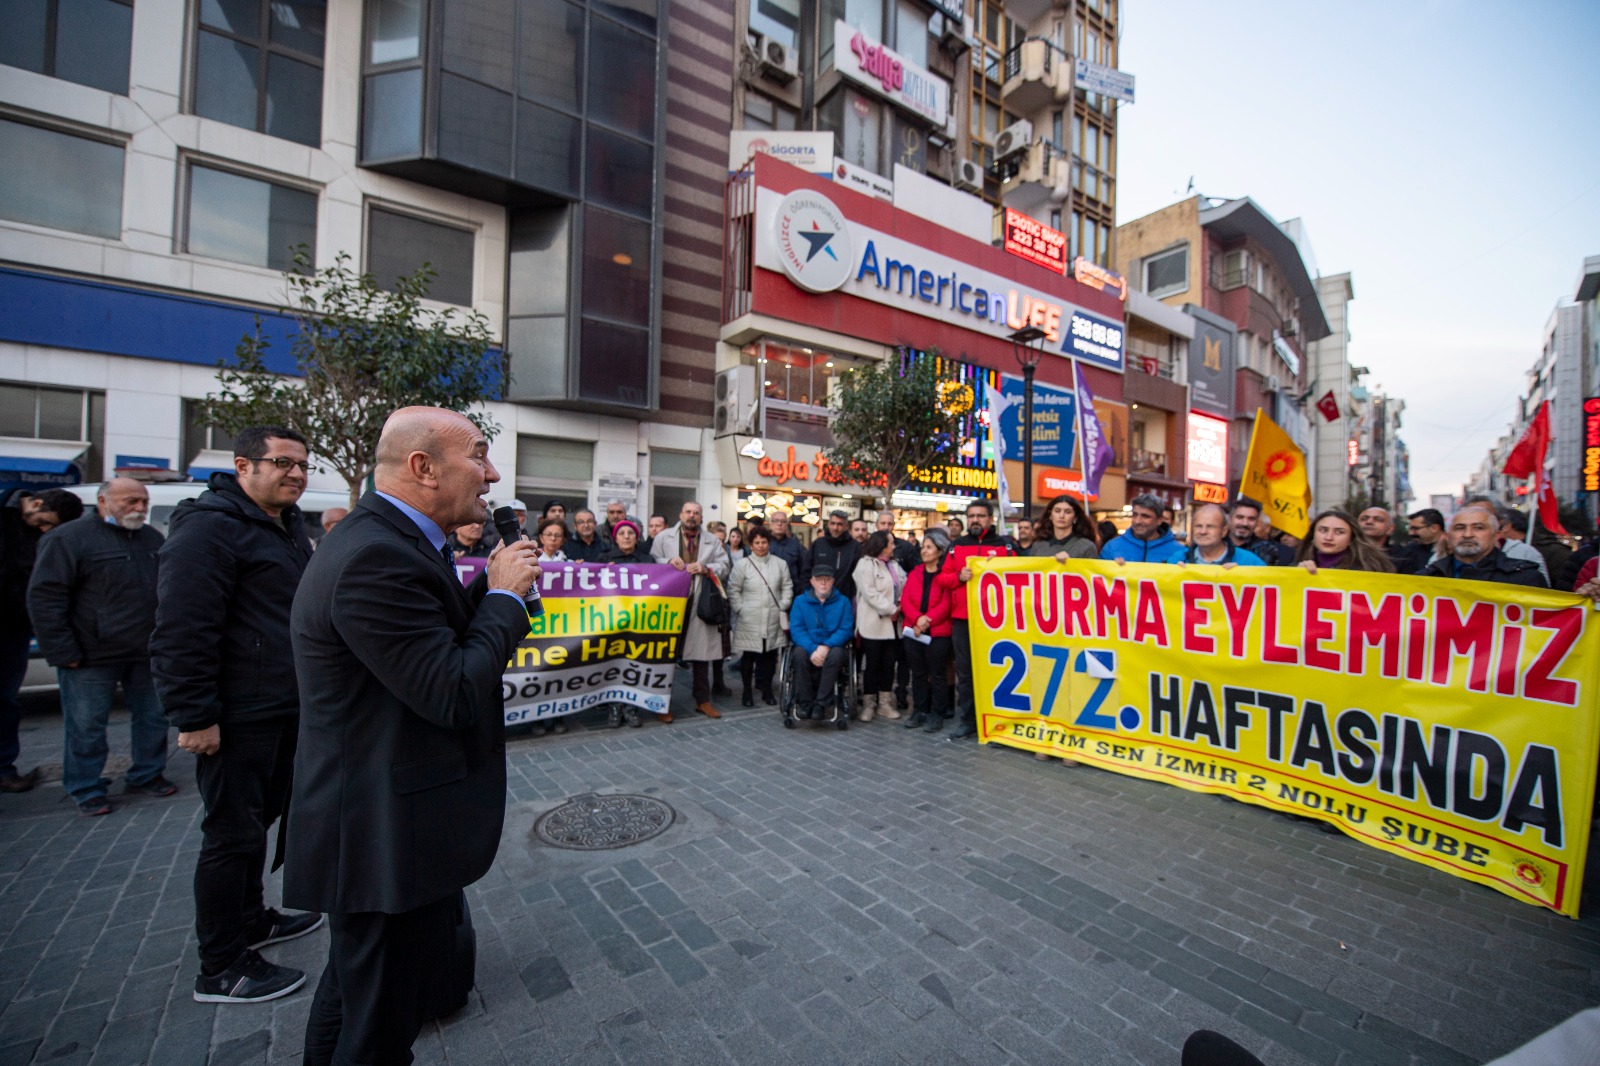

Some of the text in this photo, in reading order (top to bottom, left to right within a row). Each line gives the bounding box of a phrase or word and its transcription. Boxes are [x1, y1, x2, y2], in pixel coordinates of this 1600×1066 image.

[771, 145, 815, 155] SİGORTA
[1018, 405, 1059, 423] Üretsiz
[1016, 425, 1060, 442] Tslim!
[945, 466, 998, 490] TEKNOLOJ
[542, 566, 660, 590] rittir.
[532, 599, 682, 635] arı İhlalidir.
[980, 572, 1169, 647] OTURMA
[507, 636, 677, 669] ne Hayır!
[506, 689, 637, 722] er Platformu
[1150, 672, 1564, 849] HAFTASINDA
[1013, 722, 1490, 867] EĞİTİM SEN İZMİR 2 NOLU ŞUBE
